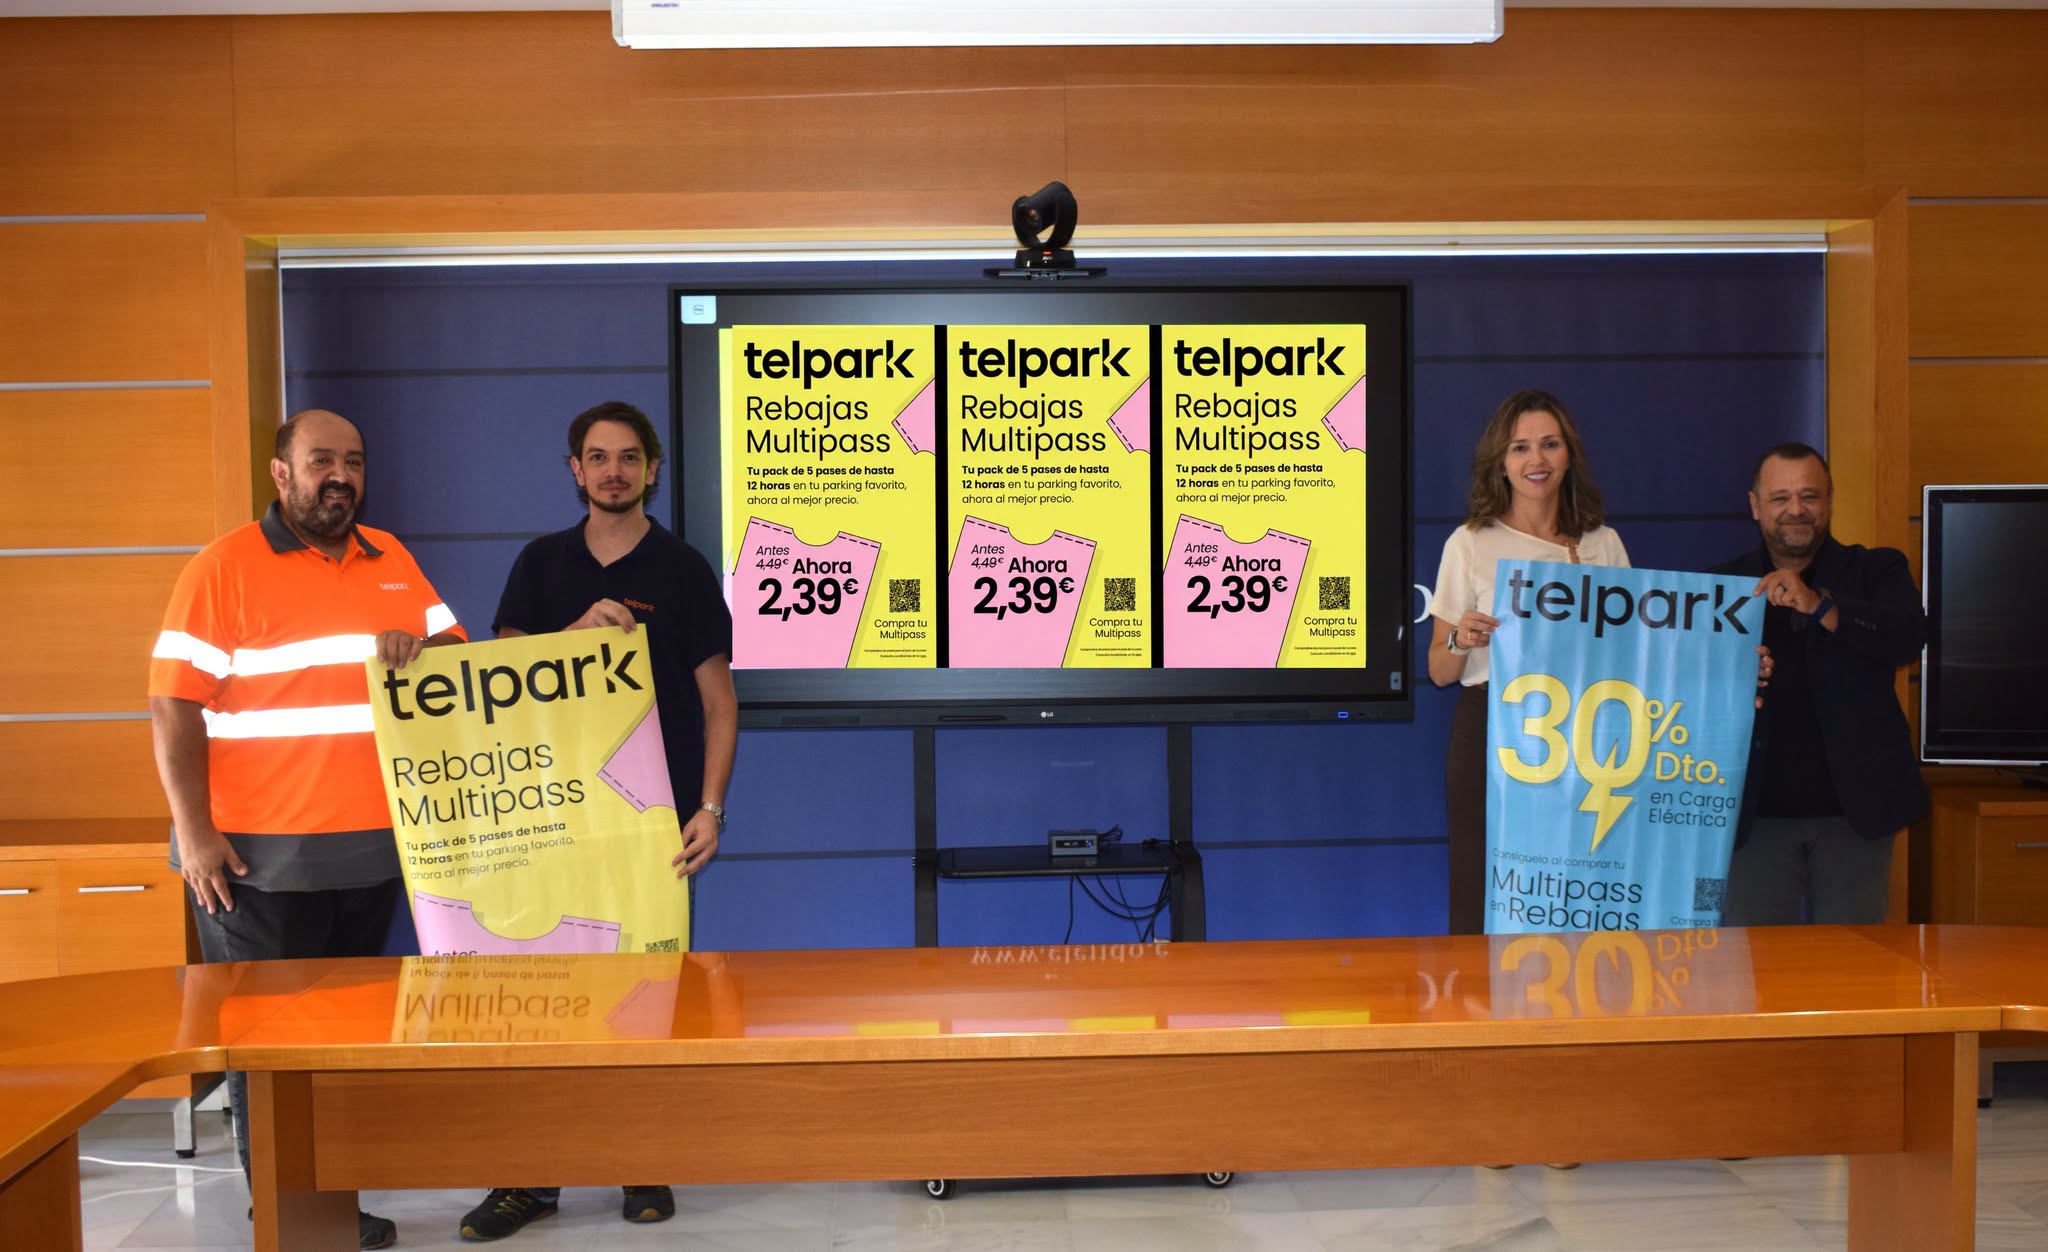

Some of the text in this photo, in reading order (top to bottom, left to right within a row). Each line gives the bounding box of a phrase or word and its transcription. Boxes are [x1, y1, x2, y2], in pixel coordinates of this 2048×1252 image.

[744, 340, 914, 389] telpark
[959, 339, 1131, 388] telpark
[1174, 337, 1345, 387] telpark
[747, 394, 868, 430] Rebajas
[962, 393, 1082, 429] Rebajas
[1176, 392, 1296, 428] Rebajas
[747, 427, 890, 461] Multipass
[962, 426, 1106, 460] Multipass
[1176, 425, 1320, 458] Multipass
[747, 466, 894, 477] Tu pack de 5 pases de hasta
[962, 465, 1109, 476] Tu pack de 5 pases de hasta
[1176, 464, 1322, 475] Tu pack de 5 pases de hasta
[747, 481, 756, 490] 12
[758, 481, 790, 490] horas
[823, 481, 862, 492] parking
[865, 480, 906, 490] favorito,
[962, 480, 972, 488] 12
[975, 480, 1005, 488] horas
[1024, 480, 1034, 488] tu
[1038, 480, 1077, 491] parking
[1080, 479, 1121, 488] favorito,
[1176, 479, 1186, 487] 12
[1189, 479, 1219, 487] horas
[1238, 479, 1248, 487] tu
[1252, 478, 1290, 489] parking
[1294, 478, 1335, 487] favorito,
[747, 496, 858, 506] ahora al mejor precio.
[962, 494, 1073, 505] ahora al mejor precio.
[1176, 493, 1287, 504] ahora al mejor precio.
[756, 546, 789, 555] Antes
[971, 544, 1005, 554] Antes
[1185, 543, 1218, 553] Antes
[792, 558, 851, 574] Ahora
[1008, 556, 1067, 573] Ahora
[1222, 555, 1281, 572] Ahora
[1509, 569, 1753, 638] telpark
[875, 620, 914, 631] Compra
[1090, 618, 1130, 630] Compra
[1304, 617, 1344, 629] Compra
[880, 628, 925, 640] Multipass
[1096, 627, 1141, 639] Multipass
[1310, 626, 1355, 638] Multipass
[384, 643, 645, 725] telpark
[393, 742, 554, 788] Rebajas
[1655, 751, 1726, 785] Dto.
[398, 779, 586, 826] Multipass
[1650, 791, 1737, 813] en Carga
[1648, 808, 1727, 828] Eléctrica
[406, 822, 566, 852] Tu pack de 5 pases de hasta
[408, 836, 576, 865] 12 horas en tu parking favorito,
[410, 870, 442, 879] ahora
[445, 868, 455, 878] al
[458, 864, 491, 877] mejor
[1551, 856, 1563, 866] al
[1564, 859, 1612, 871] comprar
[1614, 860, 1626, 871] tu
[1492, 865, 1644, 907] Multipass
[1490, 896, 1641, 931] en Rebajas
